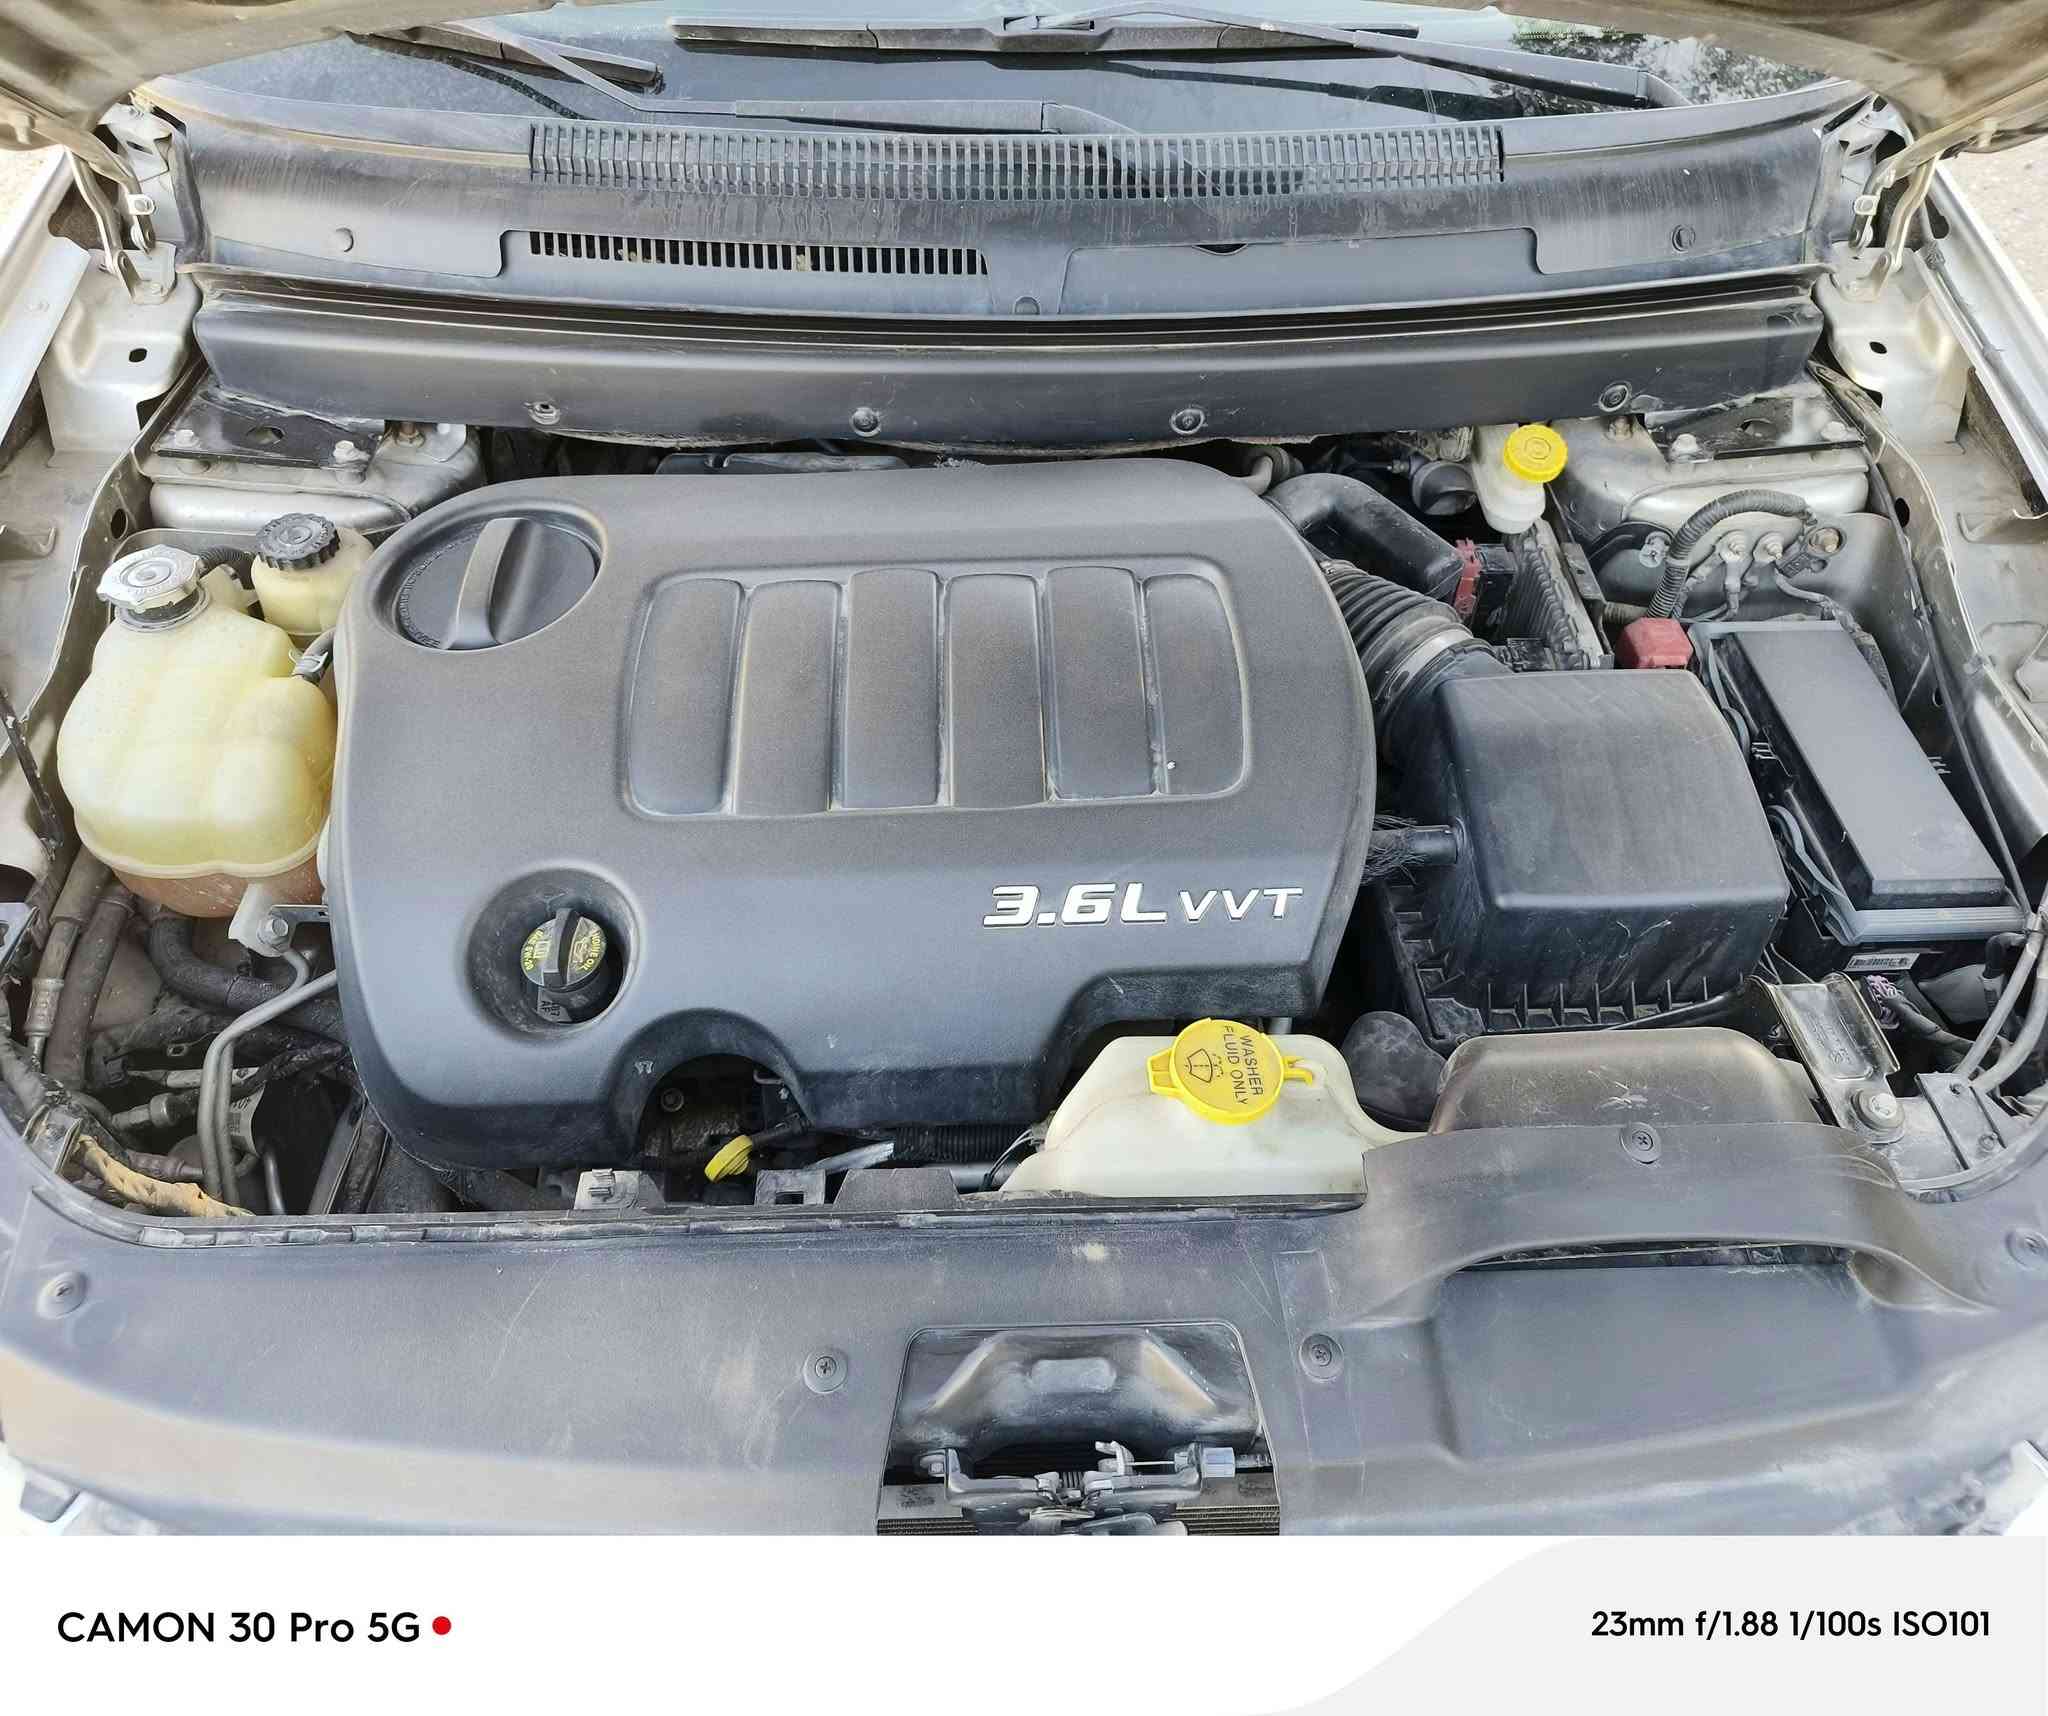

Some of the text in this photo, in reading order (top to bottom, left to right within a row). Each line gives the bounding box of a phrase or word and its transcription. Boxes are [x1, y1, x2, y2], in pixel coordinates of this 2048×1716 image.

[983, 882, 1304, 928] 3.6L VVT
[1224, 1025, 1248, 1105] FLUID ONLY
[1239, 1034, 1264, 1096] WASHER
